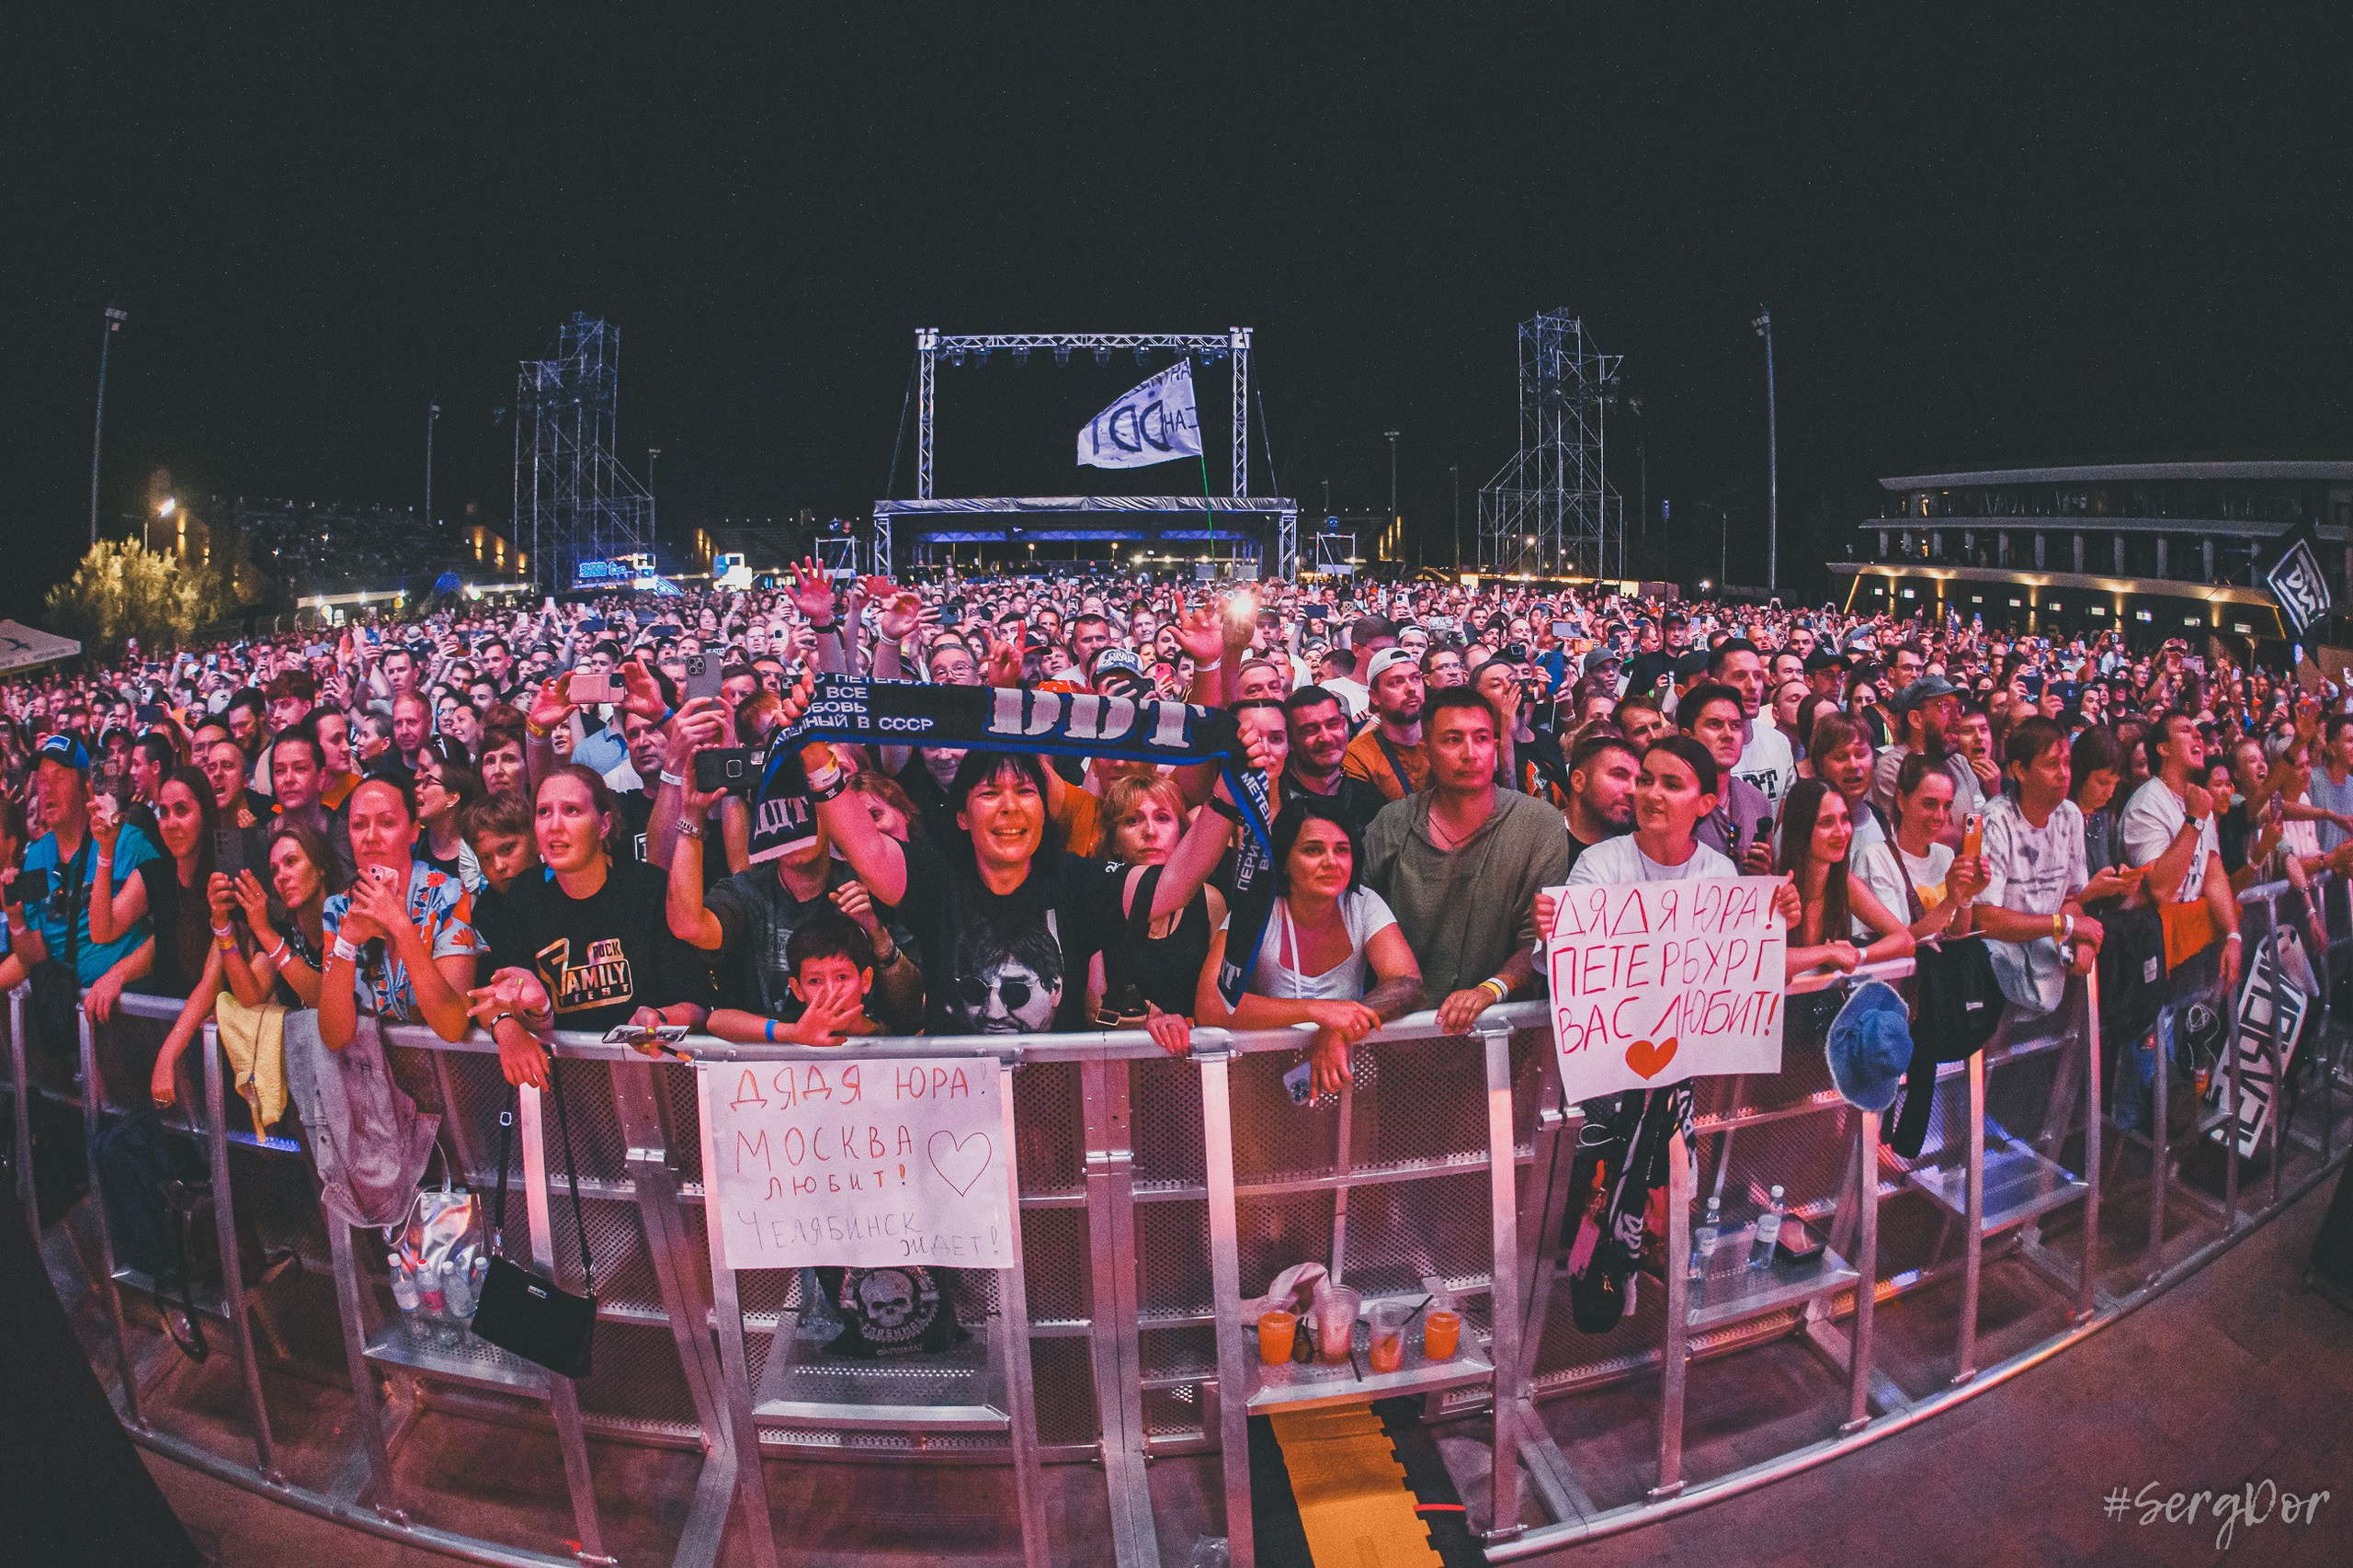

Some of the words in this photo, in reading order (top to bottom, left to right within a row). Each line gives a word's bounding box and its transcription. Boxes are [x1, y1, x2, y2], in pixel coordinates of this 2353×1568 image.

[803, 701, 868, 716] БОВЬ
[826, 686, 869, 699] ВСЕ
[858, 716, 870, 729] В
[879, 717, 934, 732] СССР
[987, 687, 1207, 748] DDT
[1550, 888, 1679, 942] ДЯДЯ
[1693, 883, 1780, 934] ЮРА!
[592, 940, 620, 959] ROCK
[1552, 937, 1780, 1005] ПЕТЕРБУРГ
[1558, 996, 1639, 1054] ВАС
[1650, 989, 1779, 1040] ЛЮБИТ!
[730, 1063, 862, 1111] ДЯДЯ
[896, 1062, 987, 1100] ЮРА!
[736, 1124, 913, 1174] МОСКВА
[764, 1163, 906, 1201] ЛЮБИТ!
[737, 1210, 925, 1251] ЧЕЛЯБИНСК
[900, 1225, 1000, 1257] ЖДЕТ!
